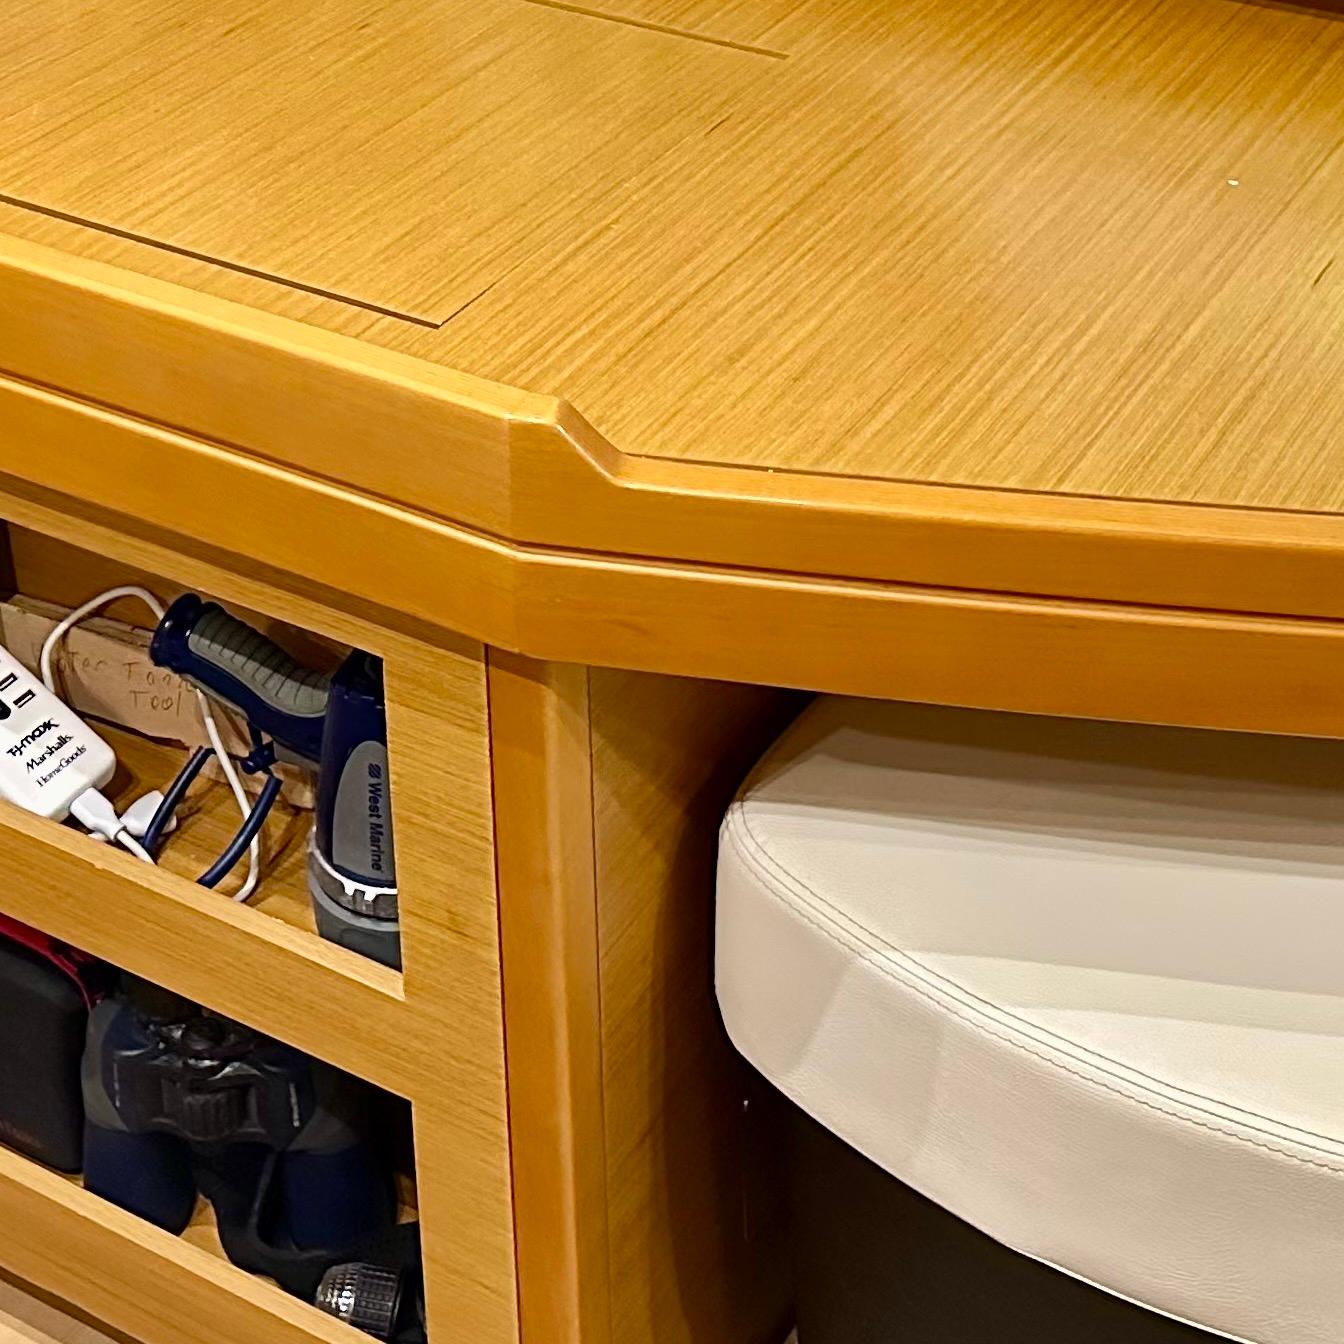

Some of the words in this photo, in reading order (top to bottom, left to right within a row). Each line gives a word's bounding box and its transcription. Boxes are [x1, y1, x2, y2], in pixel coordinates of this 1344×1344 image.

[129, 690, 182, 718] Tool
[26, 735, 74, 774] Marshalls
[36, 744, 87, 787] HomeGoods
[368, 782, 383, 819] West
[370, 822, 384, 871] Marine
